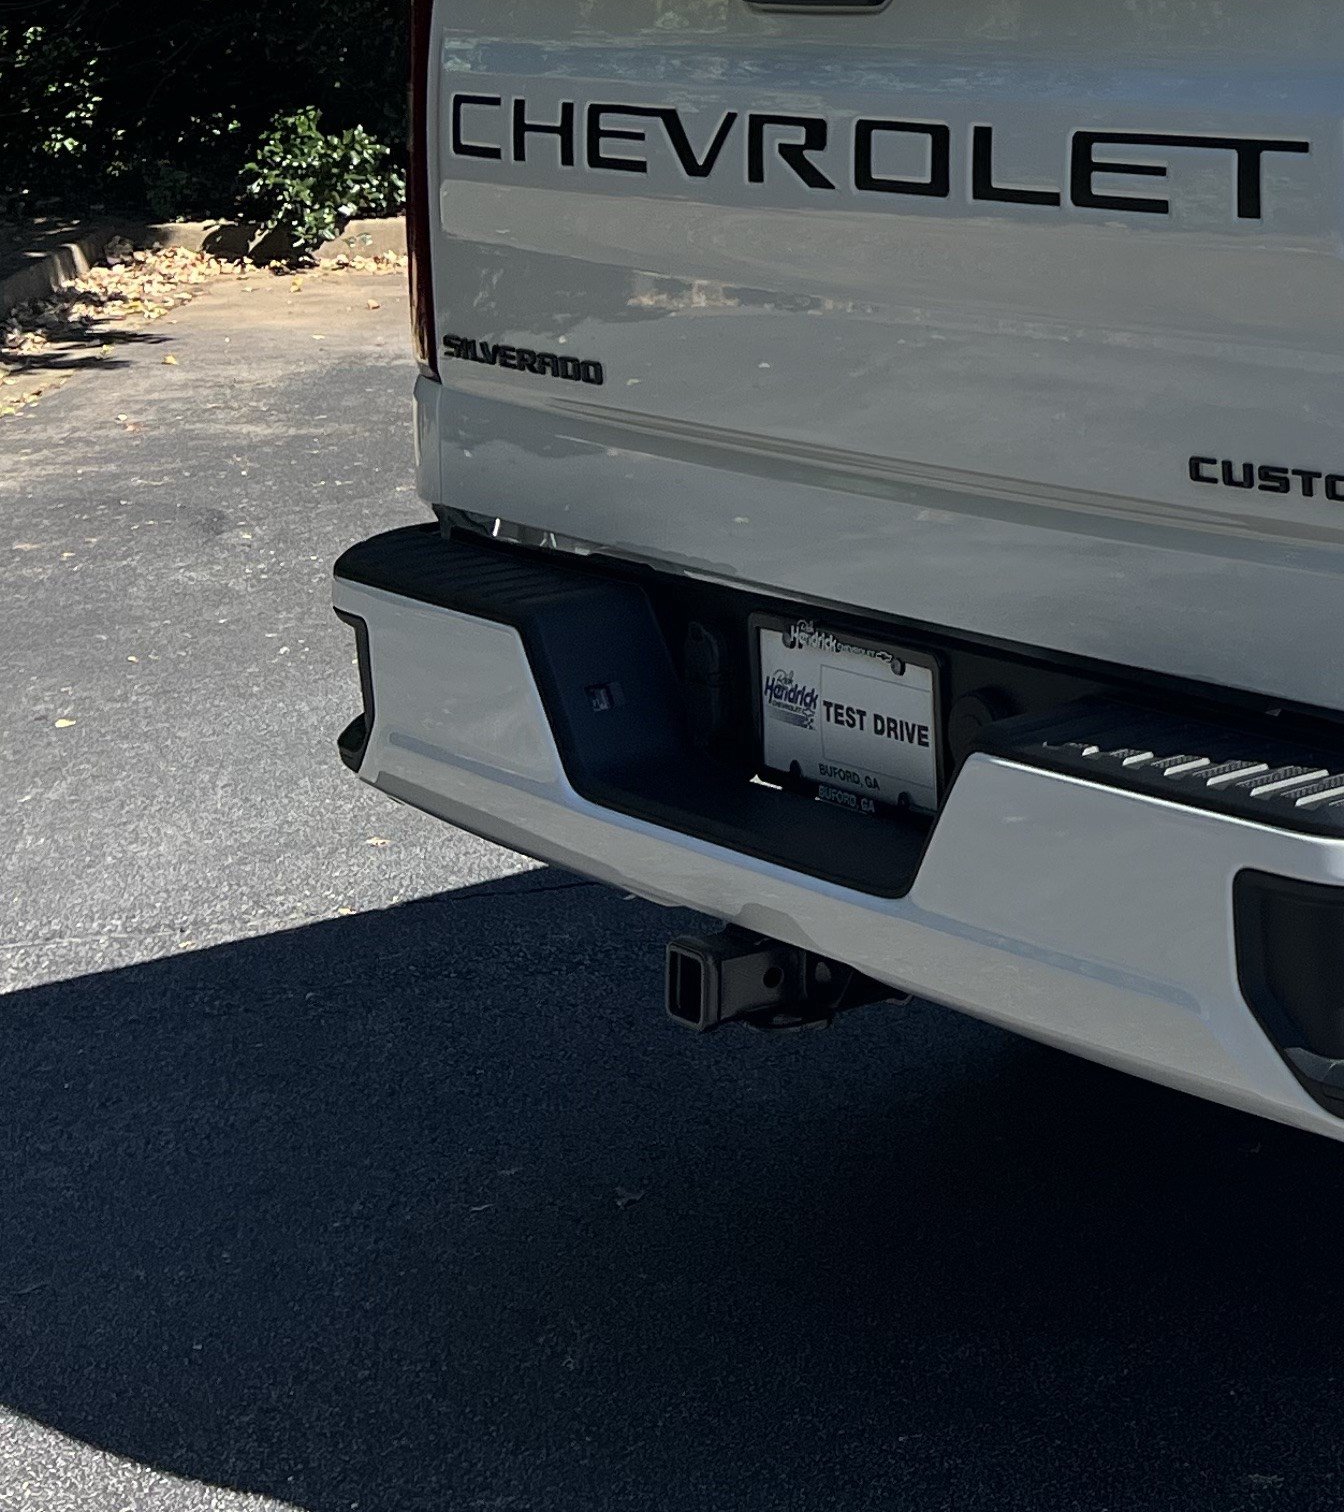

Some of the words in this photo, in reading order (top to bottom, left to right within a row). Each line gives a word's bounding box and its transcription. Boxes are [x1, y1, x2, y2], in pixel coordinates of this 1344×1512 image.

[451, 93, 1311, 220] CHEVROLET
[442, 334, 604, 385] SILVERADO
[789, 624, 837, 653] Hendrick
[764, 676, 819, 710] Hendrick
[823, 700, 867, 731] TEST
[873, 714, 930, 748] DRIVE
[818, 762, 864, 788] BUFORD,
[864, 775, 881, 791] GA
[860, 797, 876, 813] GA
